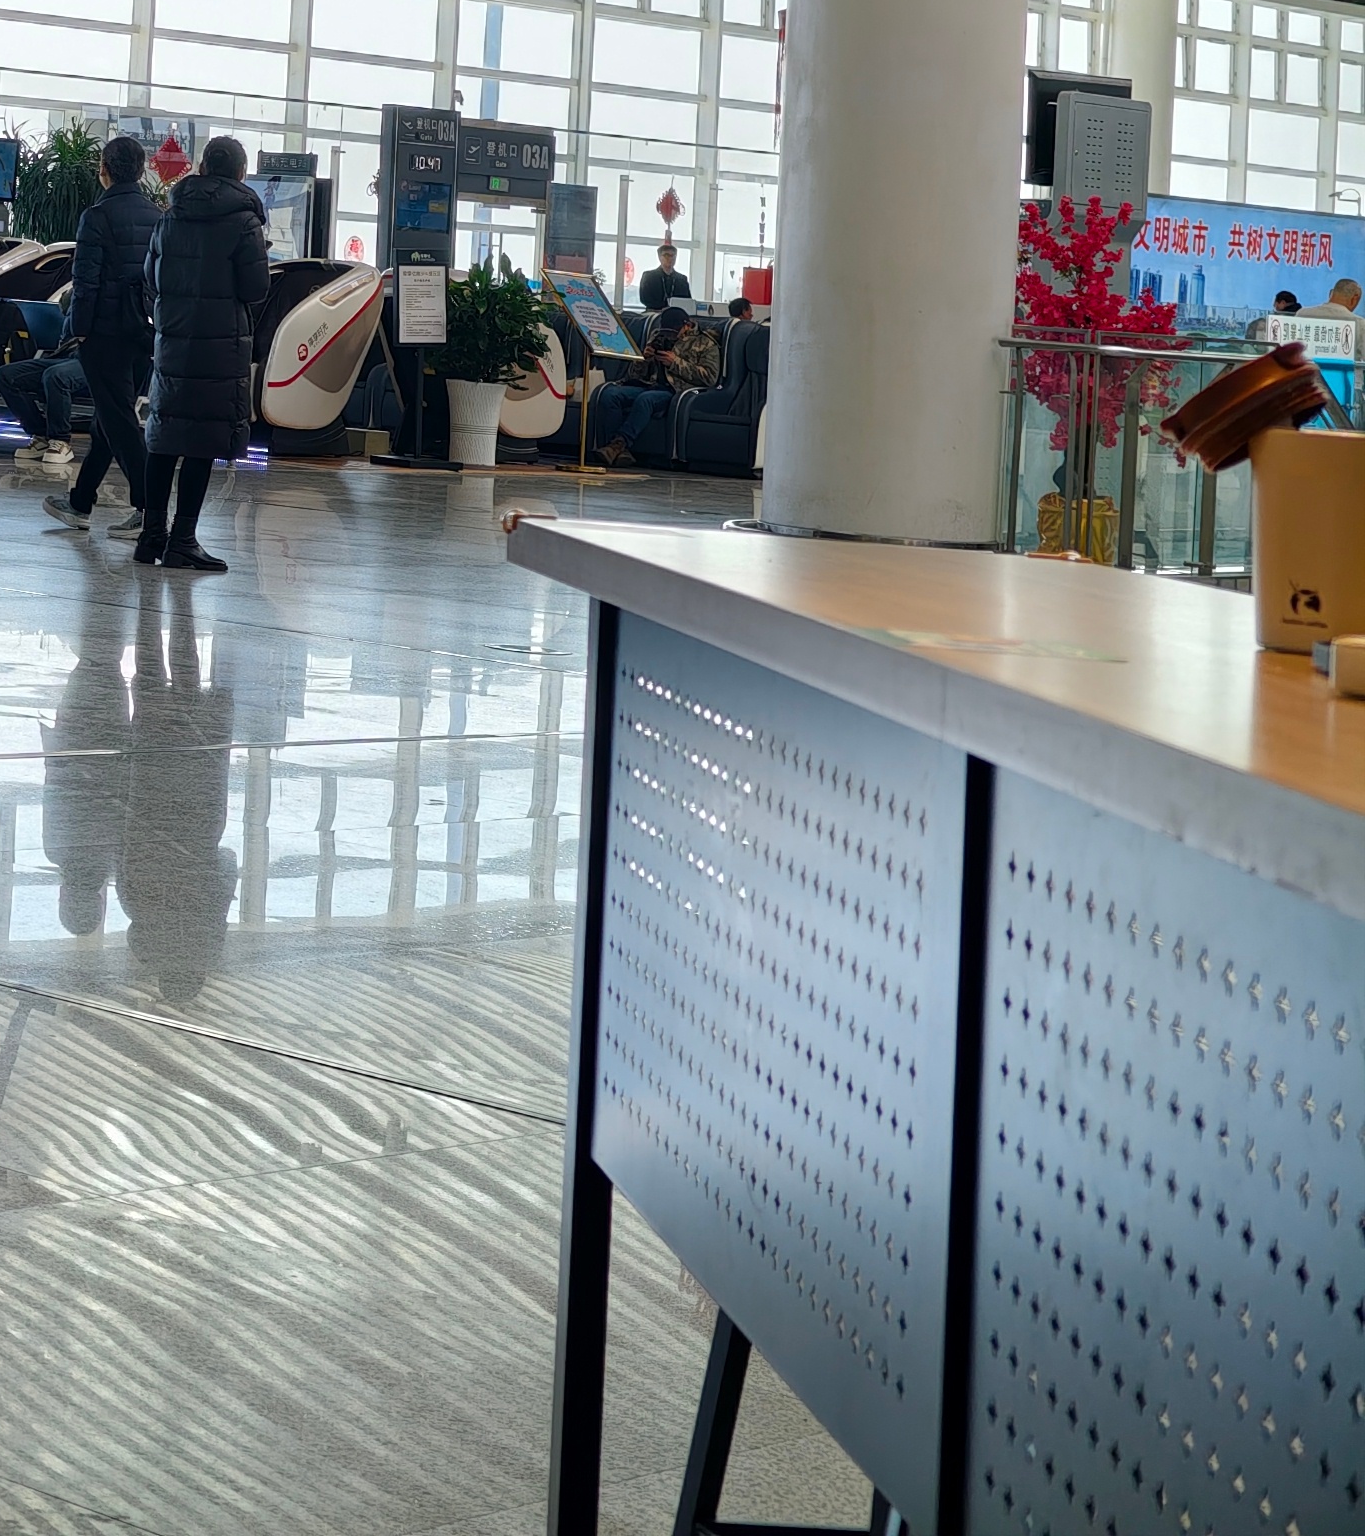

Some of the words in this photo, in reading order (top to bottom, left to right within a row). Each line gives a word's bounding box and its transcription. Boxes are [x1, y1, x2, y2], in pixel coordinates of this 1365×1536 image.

[416, 117, 437, 131] 登机口
[438, 120, 455, 142] 03A
[420, 133, 433, 141] Gate
[486, 141, 518, 157] 登机口
[522, 143, 549, 170] 03A
[495, 160, 507, 168] Gate
